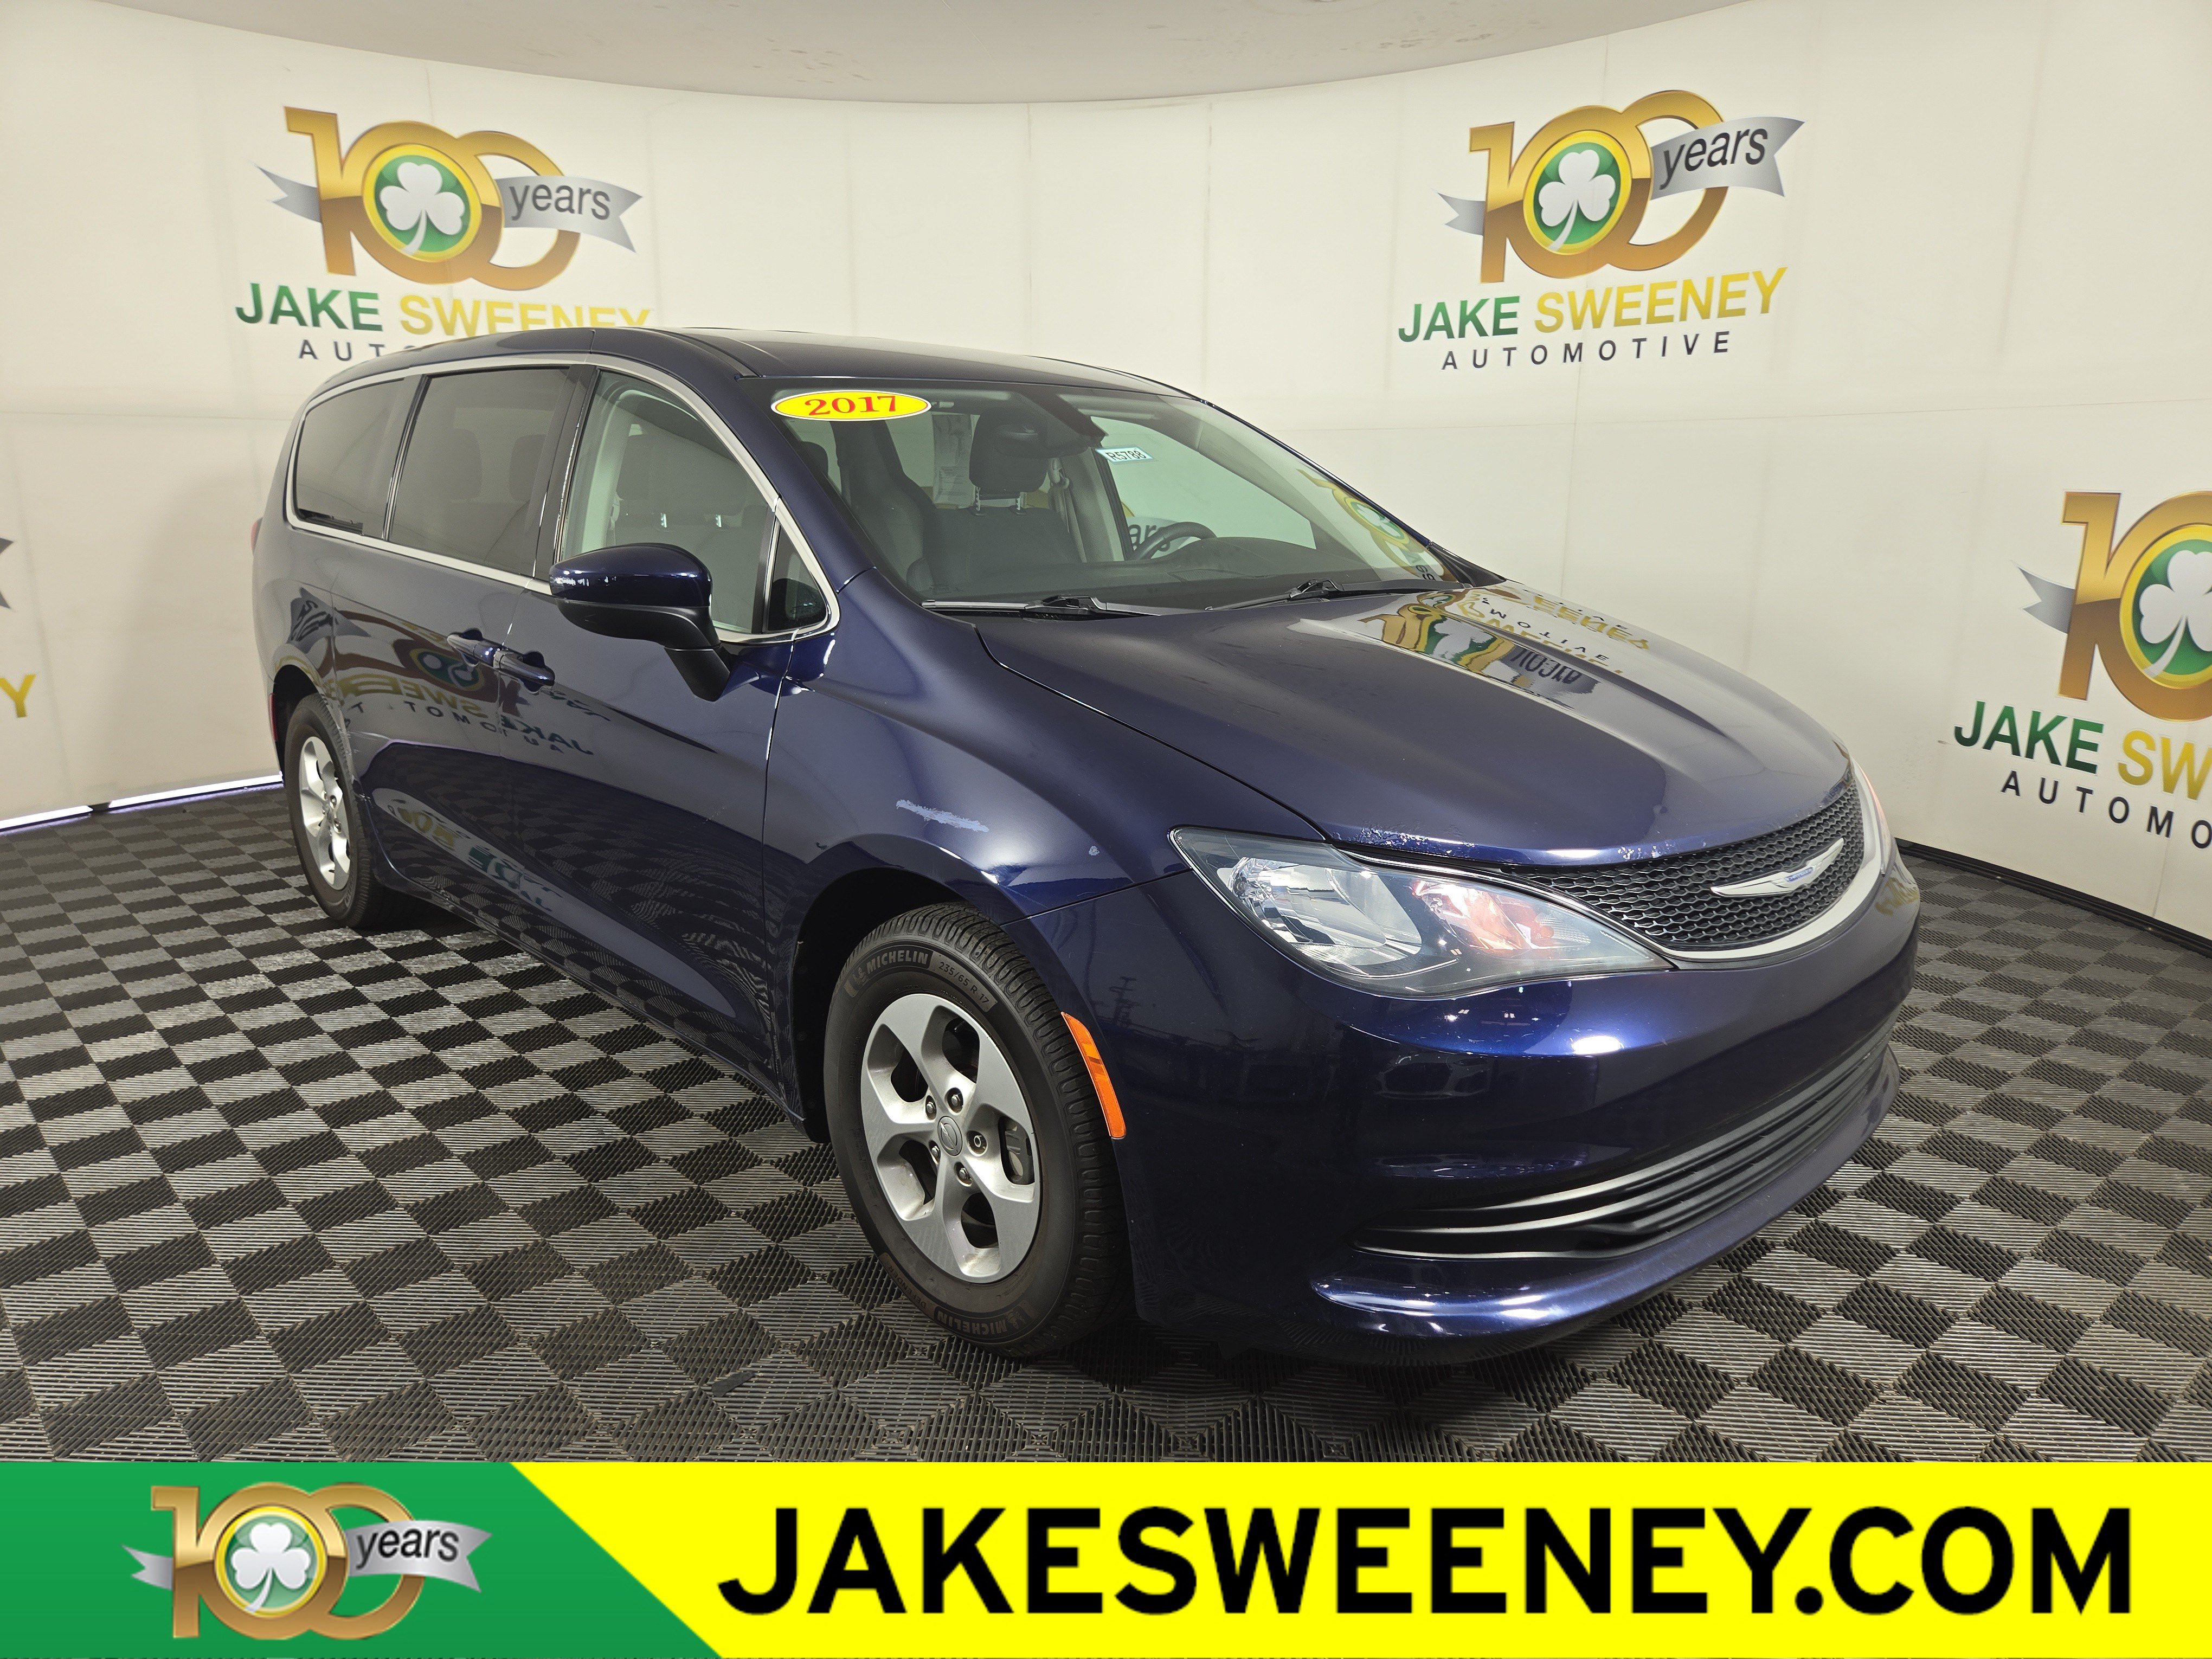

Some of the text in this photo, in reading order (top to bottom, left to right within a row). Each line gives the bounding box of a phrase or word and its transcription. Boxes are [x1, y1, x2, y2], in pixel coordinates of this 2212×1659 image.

[1658, 126, 1769, 190] years
[509, 181, 612, 221] years
[235, 282, 383, 332] JAKE
[1398, 266, 1788, 343] JAKE SWEENEY
[299, 339, 416, 362] AUT
[1441, 330, 1732, 371] AUTOMOTIVE
[805, 395, 897, 416] 2017
[1104, 450, 1147, 461] R5788
[1953, 700, 2105, 775] JAKE
[866, 949, 929, 975] MICHELIN
[938, 961, 970, 987] 235/65
[970, 984, 979, 994] R
[979, 994, 990, 1004] 17
[937, 1310, 1008, 1335] MICHELIN
